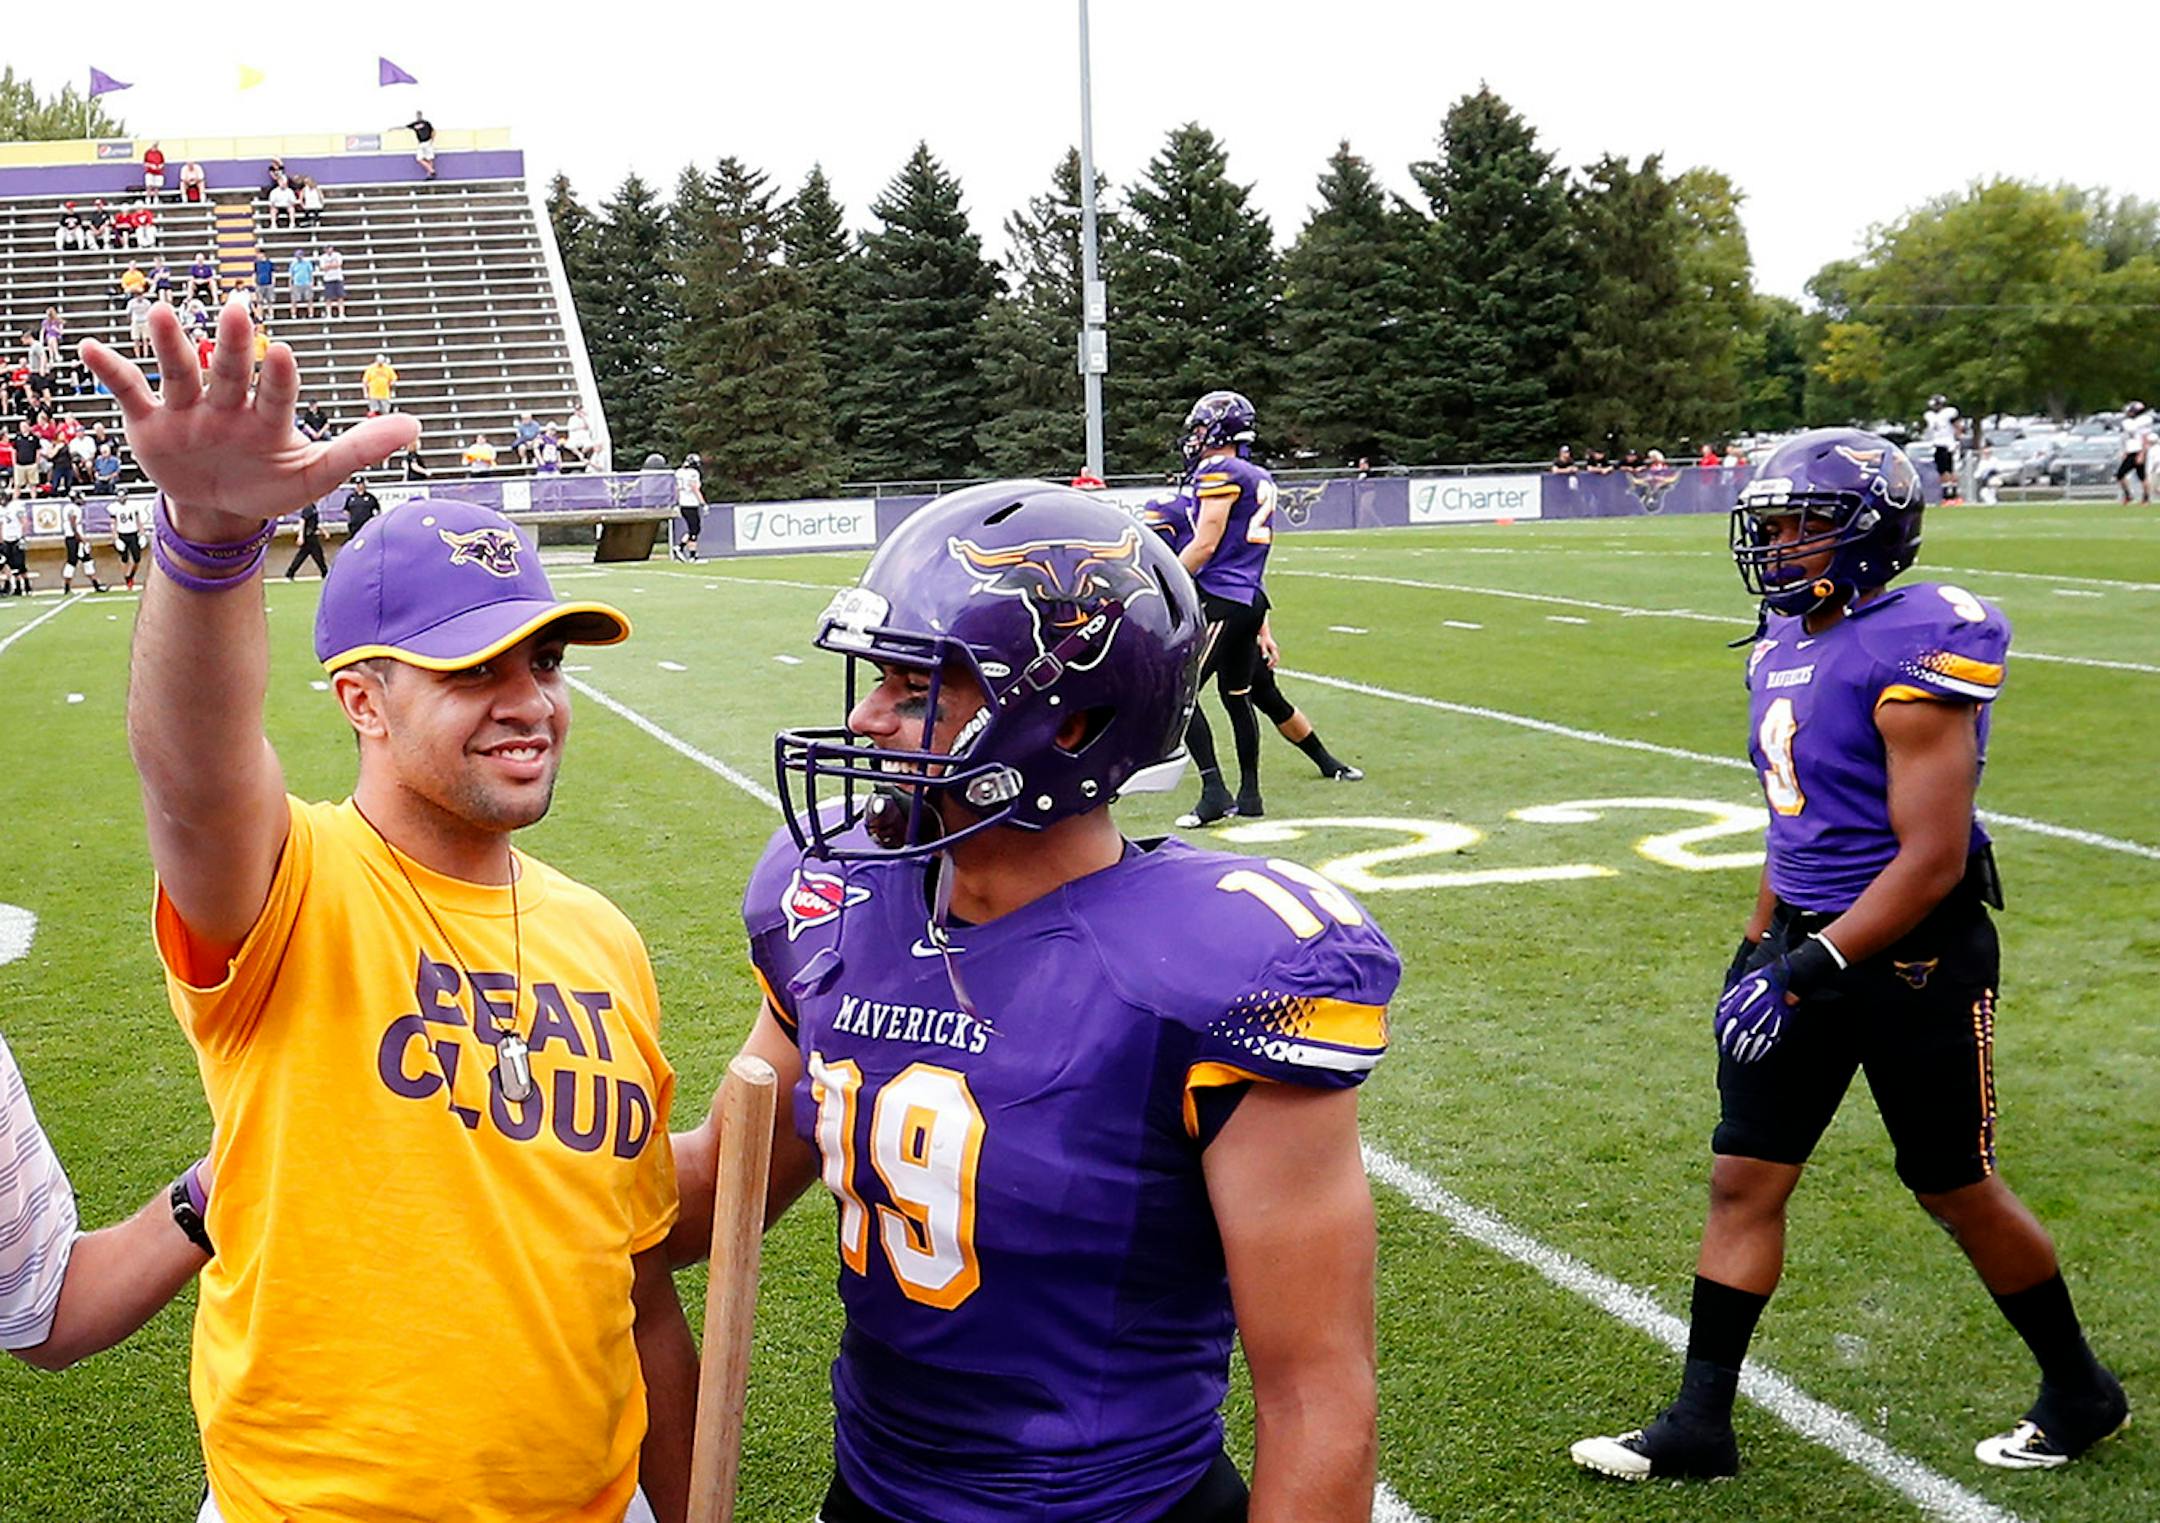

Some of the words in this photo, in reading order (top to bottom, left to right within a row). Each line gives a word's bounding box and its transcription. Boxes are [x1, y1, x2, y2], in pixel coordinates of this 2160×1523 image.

[769, 513, 862, 537] Charter
[1442, 487, 1529, 510] Charter
[1759, 697, 1807, 817] 9
[415, 948, 613, 1063] BEAT
[833, 995, 992, 1055] MAVERICKS
[378, 1014, 652, 1160] CLOUD
[808, 1051, 988, 1312] 19
